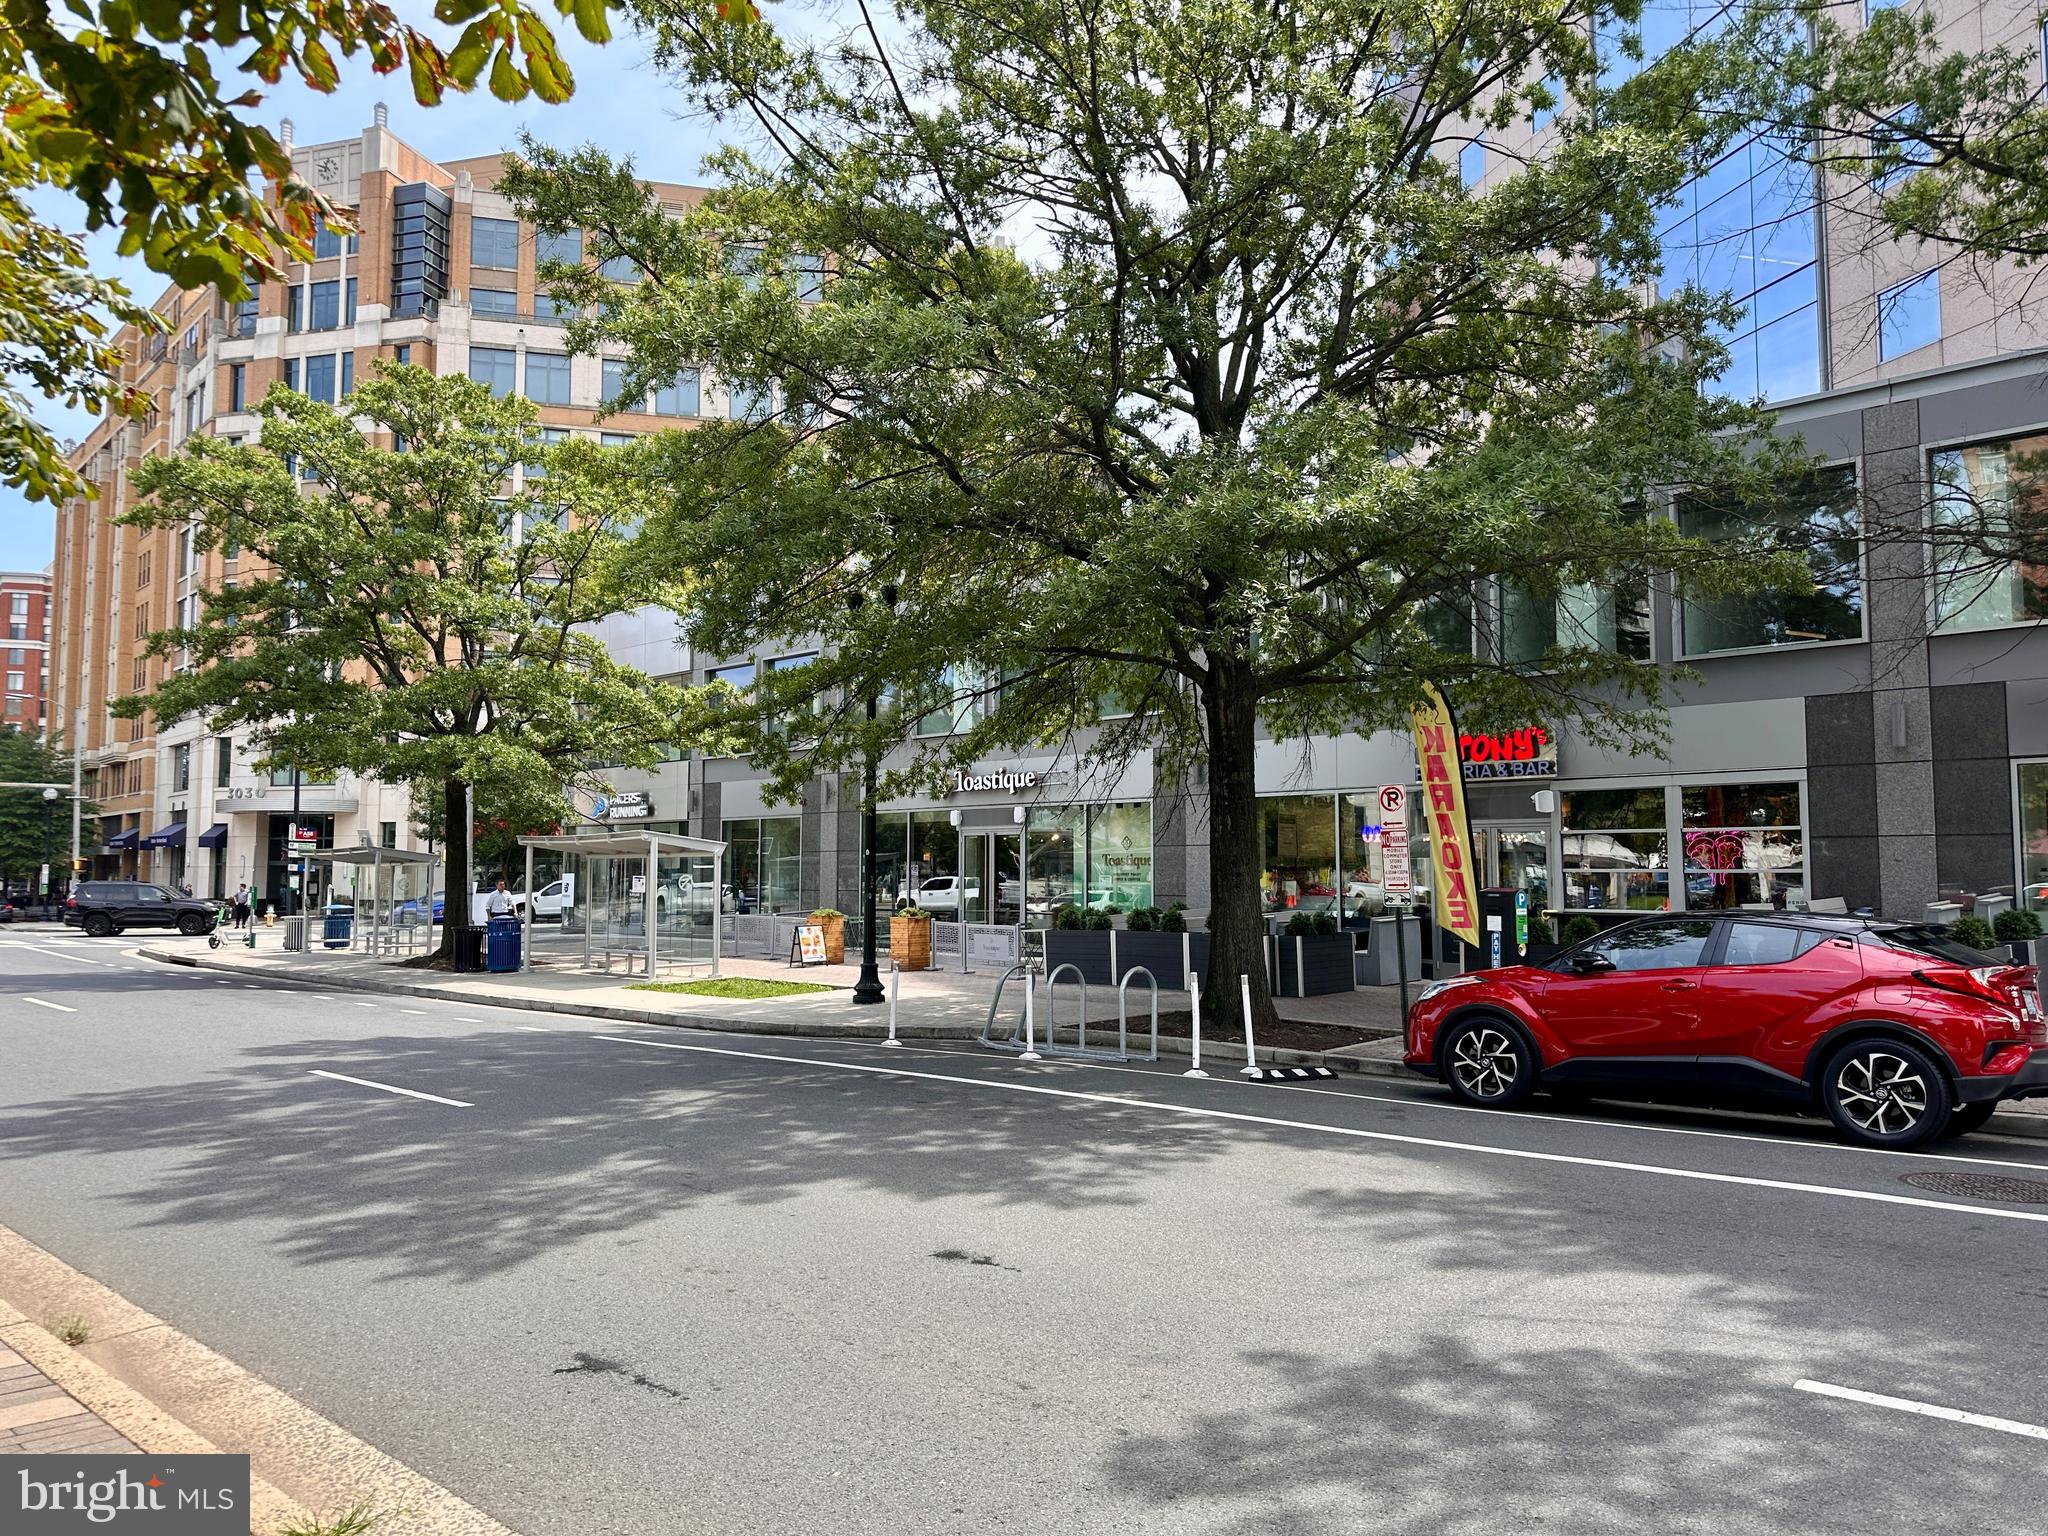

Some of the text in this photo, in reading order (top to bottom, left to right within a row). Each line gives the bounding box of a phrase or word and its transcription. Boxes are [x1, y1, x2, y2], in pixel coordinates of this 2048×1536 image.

[1497, 763, 1508, 777] &
[1513, 761, 1550, 777] BAR
[953, 767, 1036, 795] Toastique
[227, 787, 266, 799] 3030
[610, 792, 641, 804] PACERS
[610, 805, 647, 818] RUNNING
[1518, 893, 1526, 906] P
